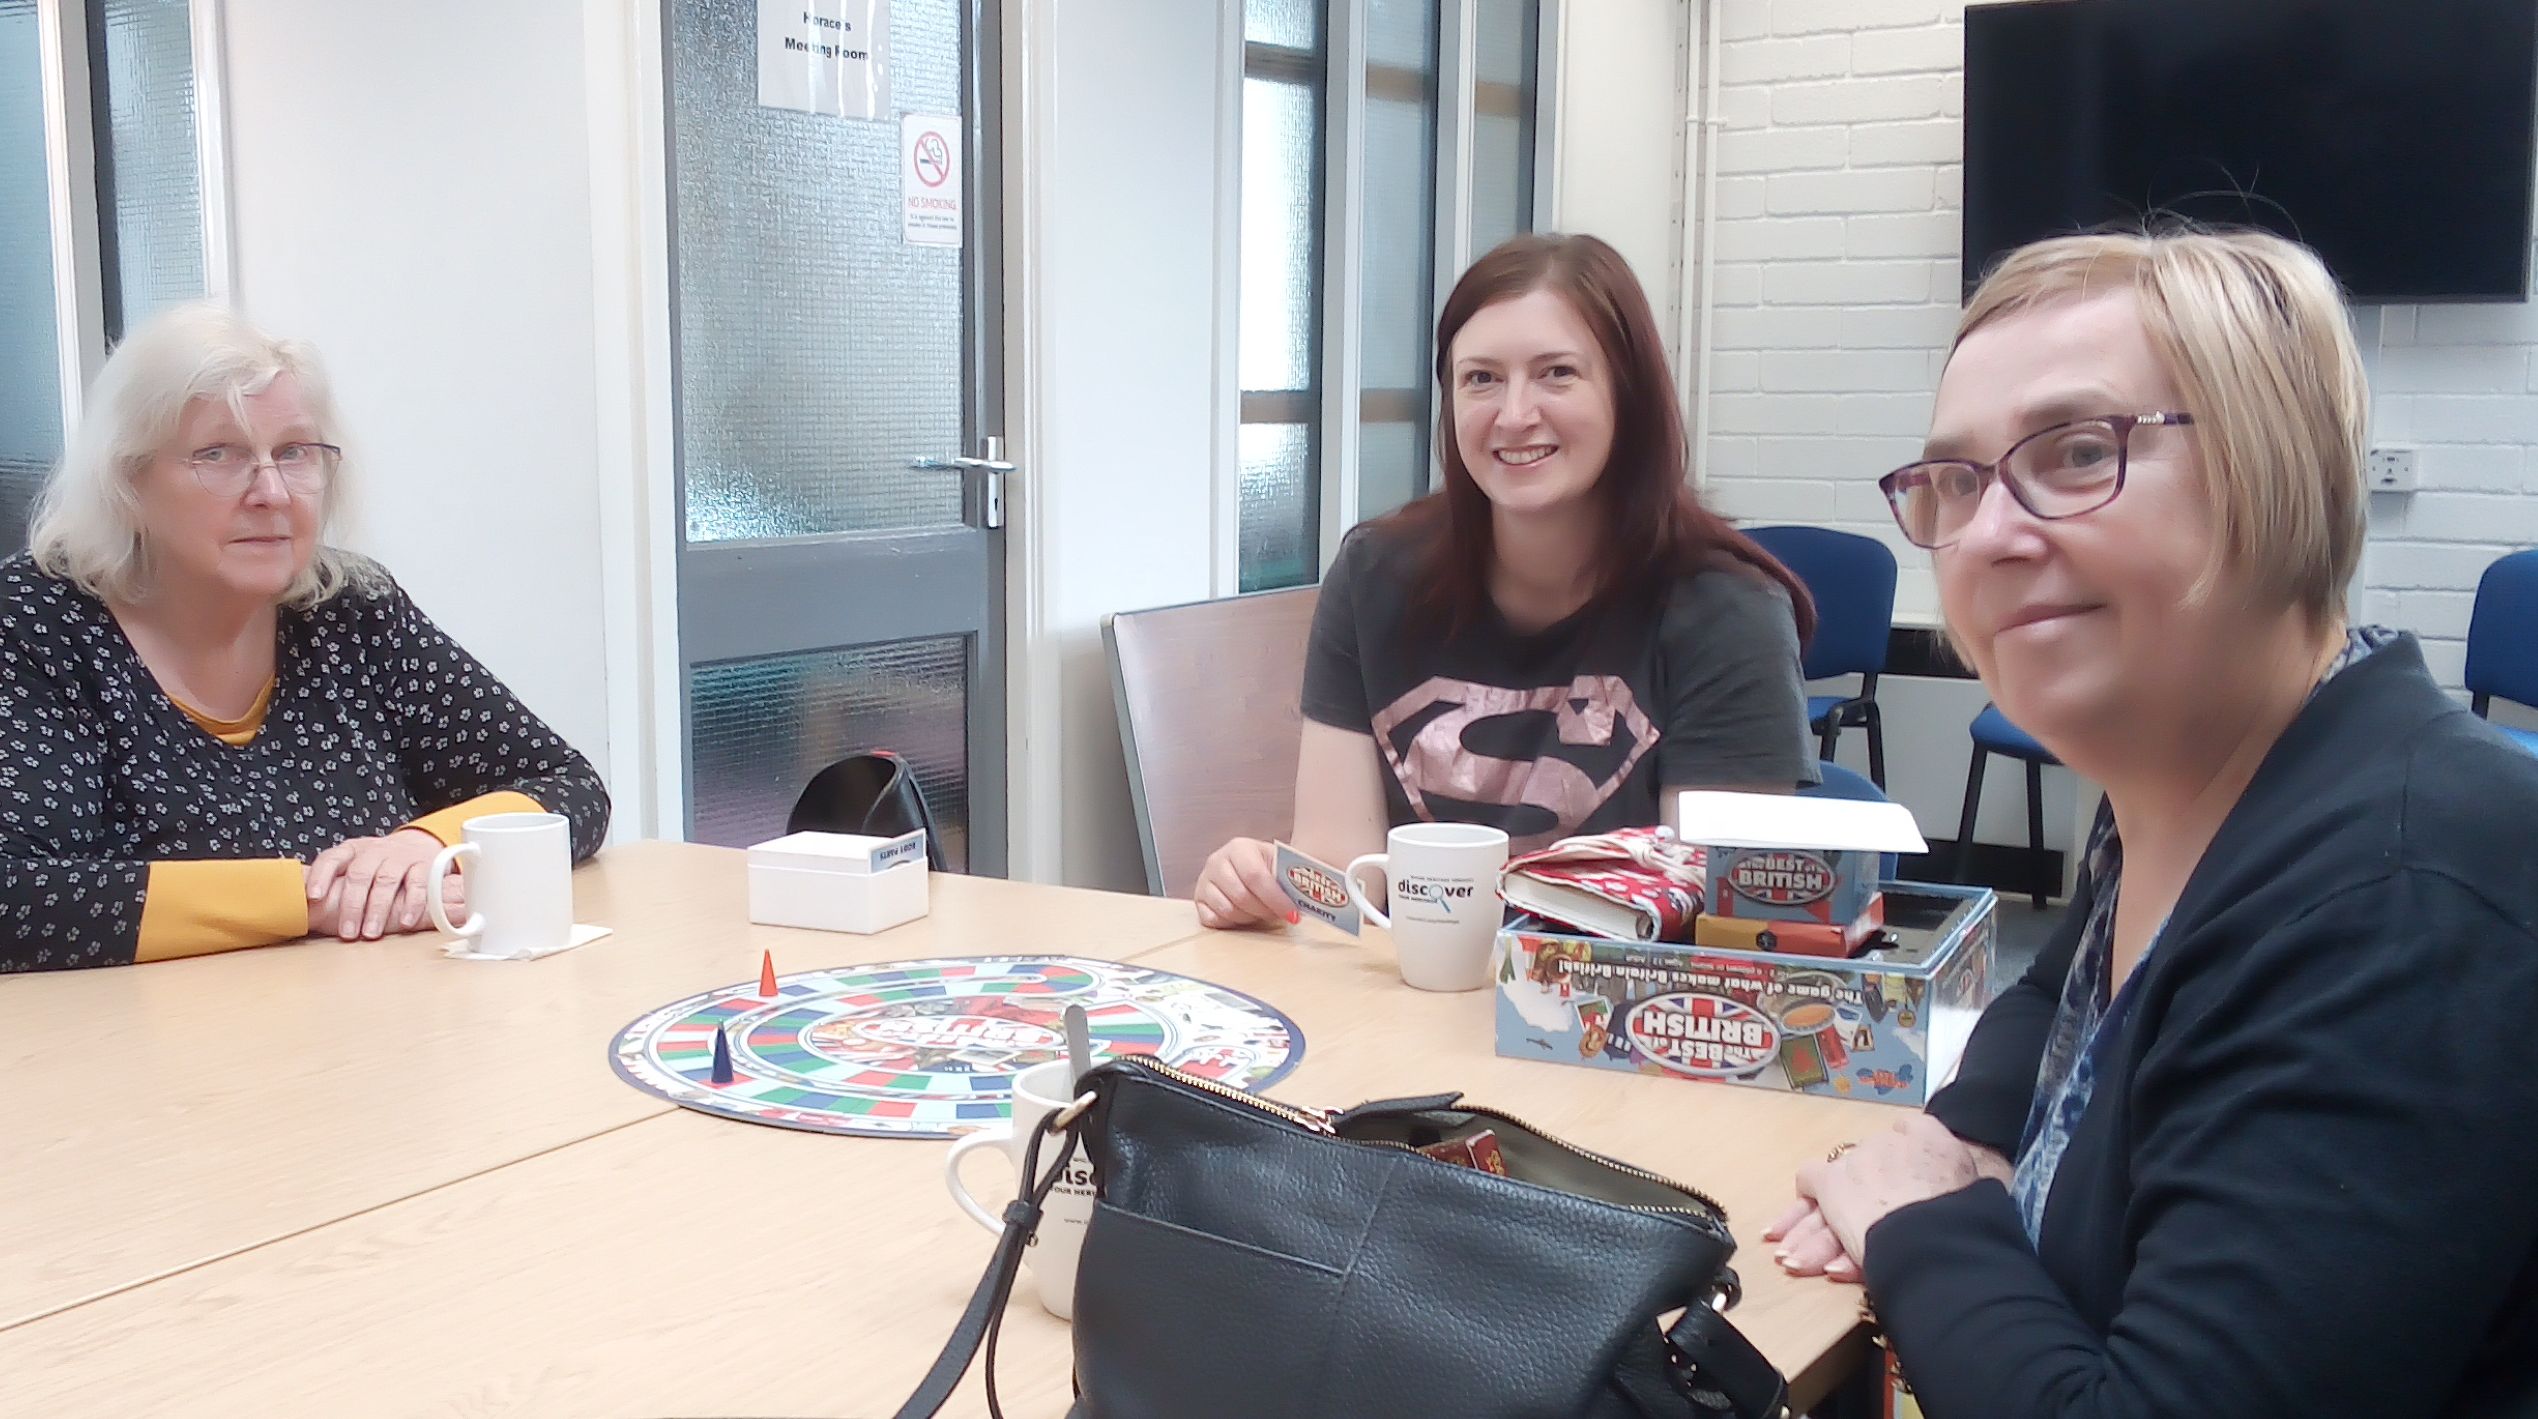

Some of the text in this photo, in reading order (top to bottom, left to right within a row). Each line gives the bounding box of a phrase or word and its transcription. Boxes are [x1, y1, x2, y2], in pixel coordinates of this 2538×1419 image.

[803, 11, 852, 32] Horaces
[785, 36, 832, 59] Meeting
[908, 196, 957, 210] NO SMOKING
[1738, 869, 1823, 891] BRITISH
[1558, 959, 1863, 1004] The game of what makes Britain British!
[1643, 1010, 1763, 1047] BRITISH
[1668, 1038, 1723, 1062] BEST
